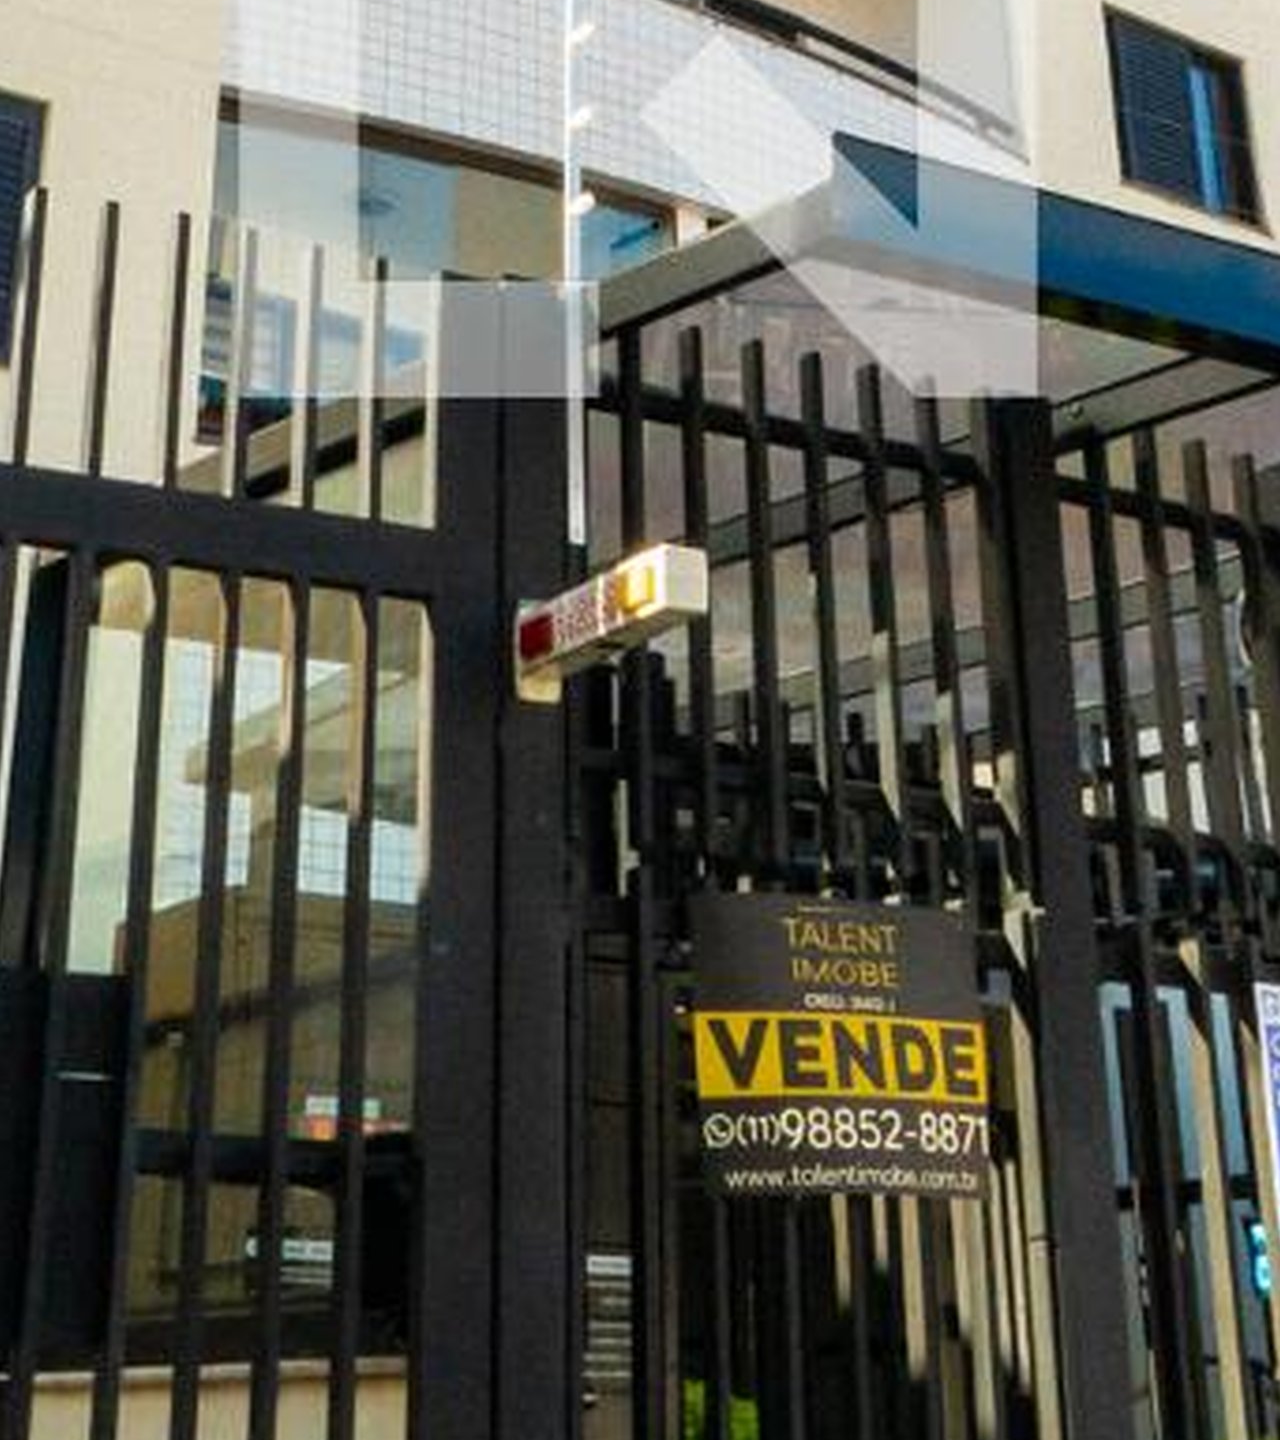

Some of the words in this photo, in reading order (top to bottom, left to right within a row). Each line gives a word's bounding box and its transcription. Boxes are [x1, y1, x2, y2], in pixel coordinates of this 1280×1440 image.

[784, 917, 898, 955] TALENT
[792, 958, 899, 990] IMOBE
[706, 1018, 981, 1098] VENDE
